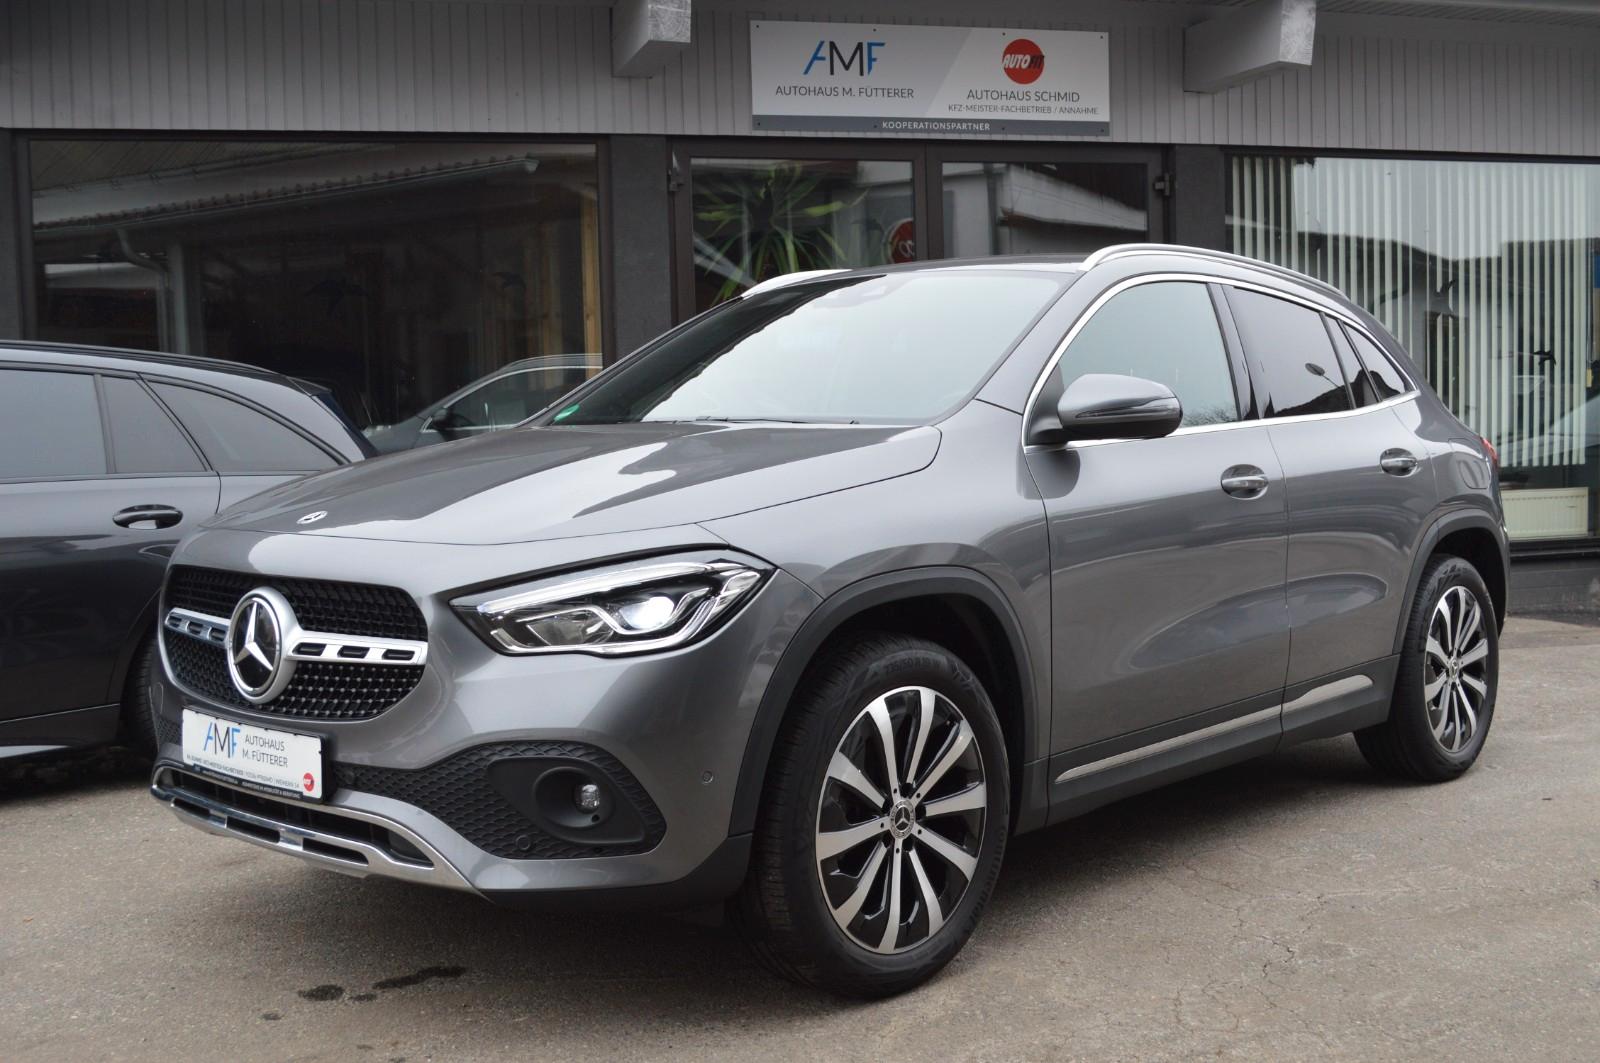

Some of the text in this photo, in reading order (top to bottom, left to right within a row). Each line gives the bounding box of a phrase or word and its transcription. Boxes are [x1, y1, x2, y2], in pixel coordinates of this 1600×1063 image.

[803, 40, 886, 76] AMF
[775, 85, 914, 99] AUTOHAUS M. FÜTTERER
[966, 89, 1080, 102] AUTOHAUS SCHMID
[948, 104, 1052, 114] KFZ-MEISTER-FACHBETRIEB
[1058, 106, 1099, 115] ANNAHME
[882, 121, 990, 131] KOOPERATIONSPARTNER
[203, 722, 241, 759] AMF
[244, 734, 285, 752] AUTOHAUS
[242, 748, 251, 760] M.
[251, 749, 289, 769] FÜTTERER
